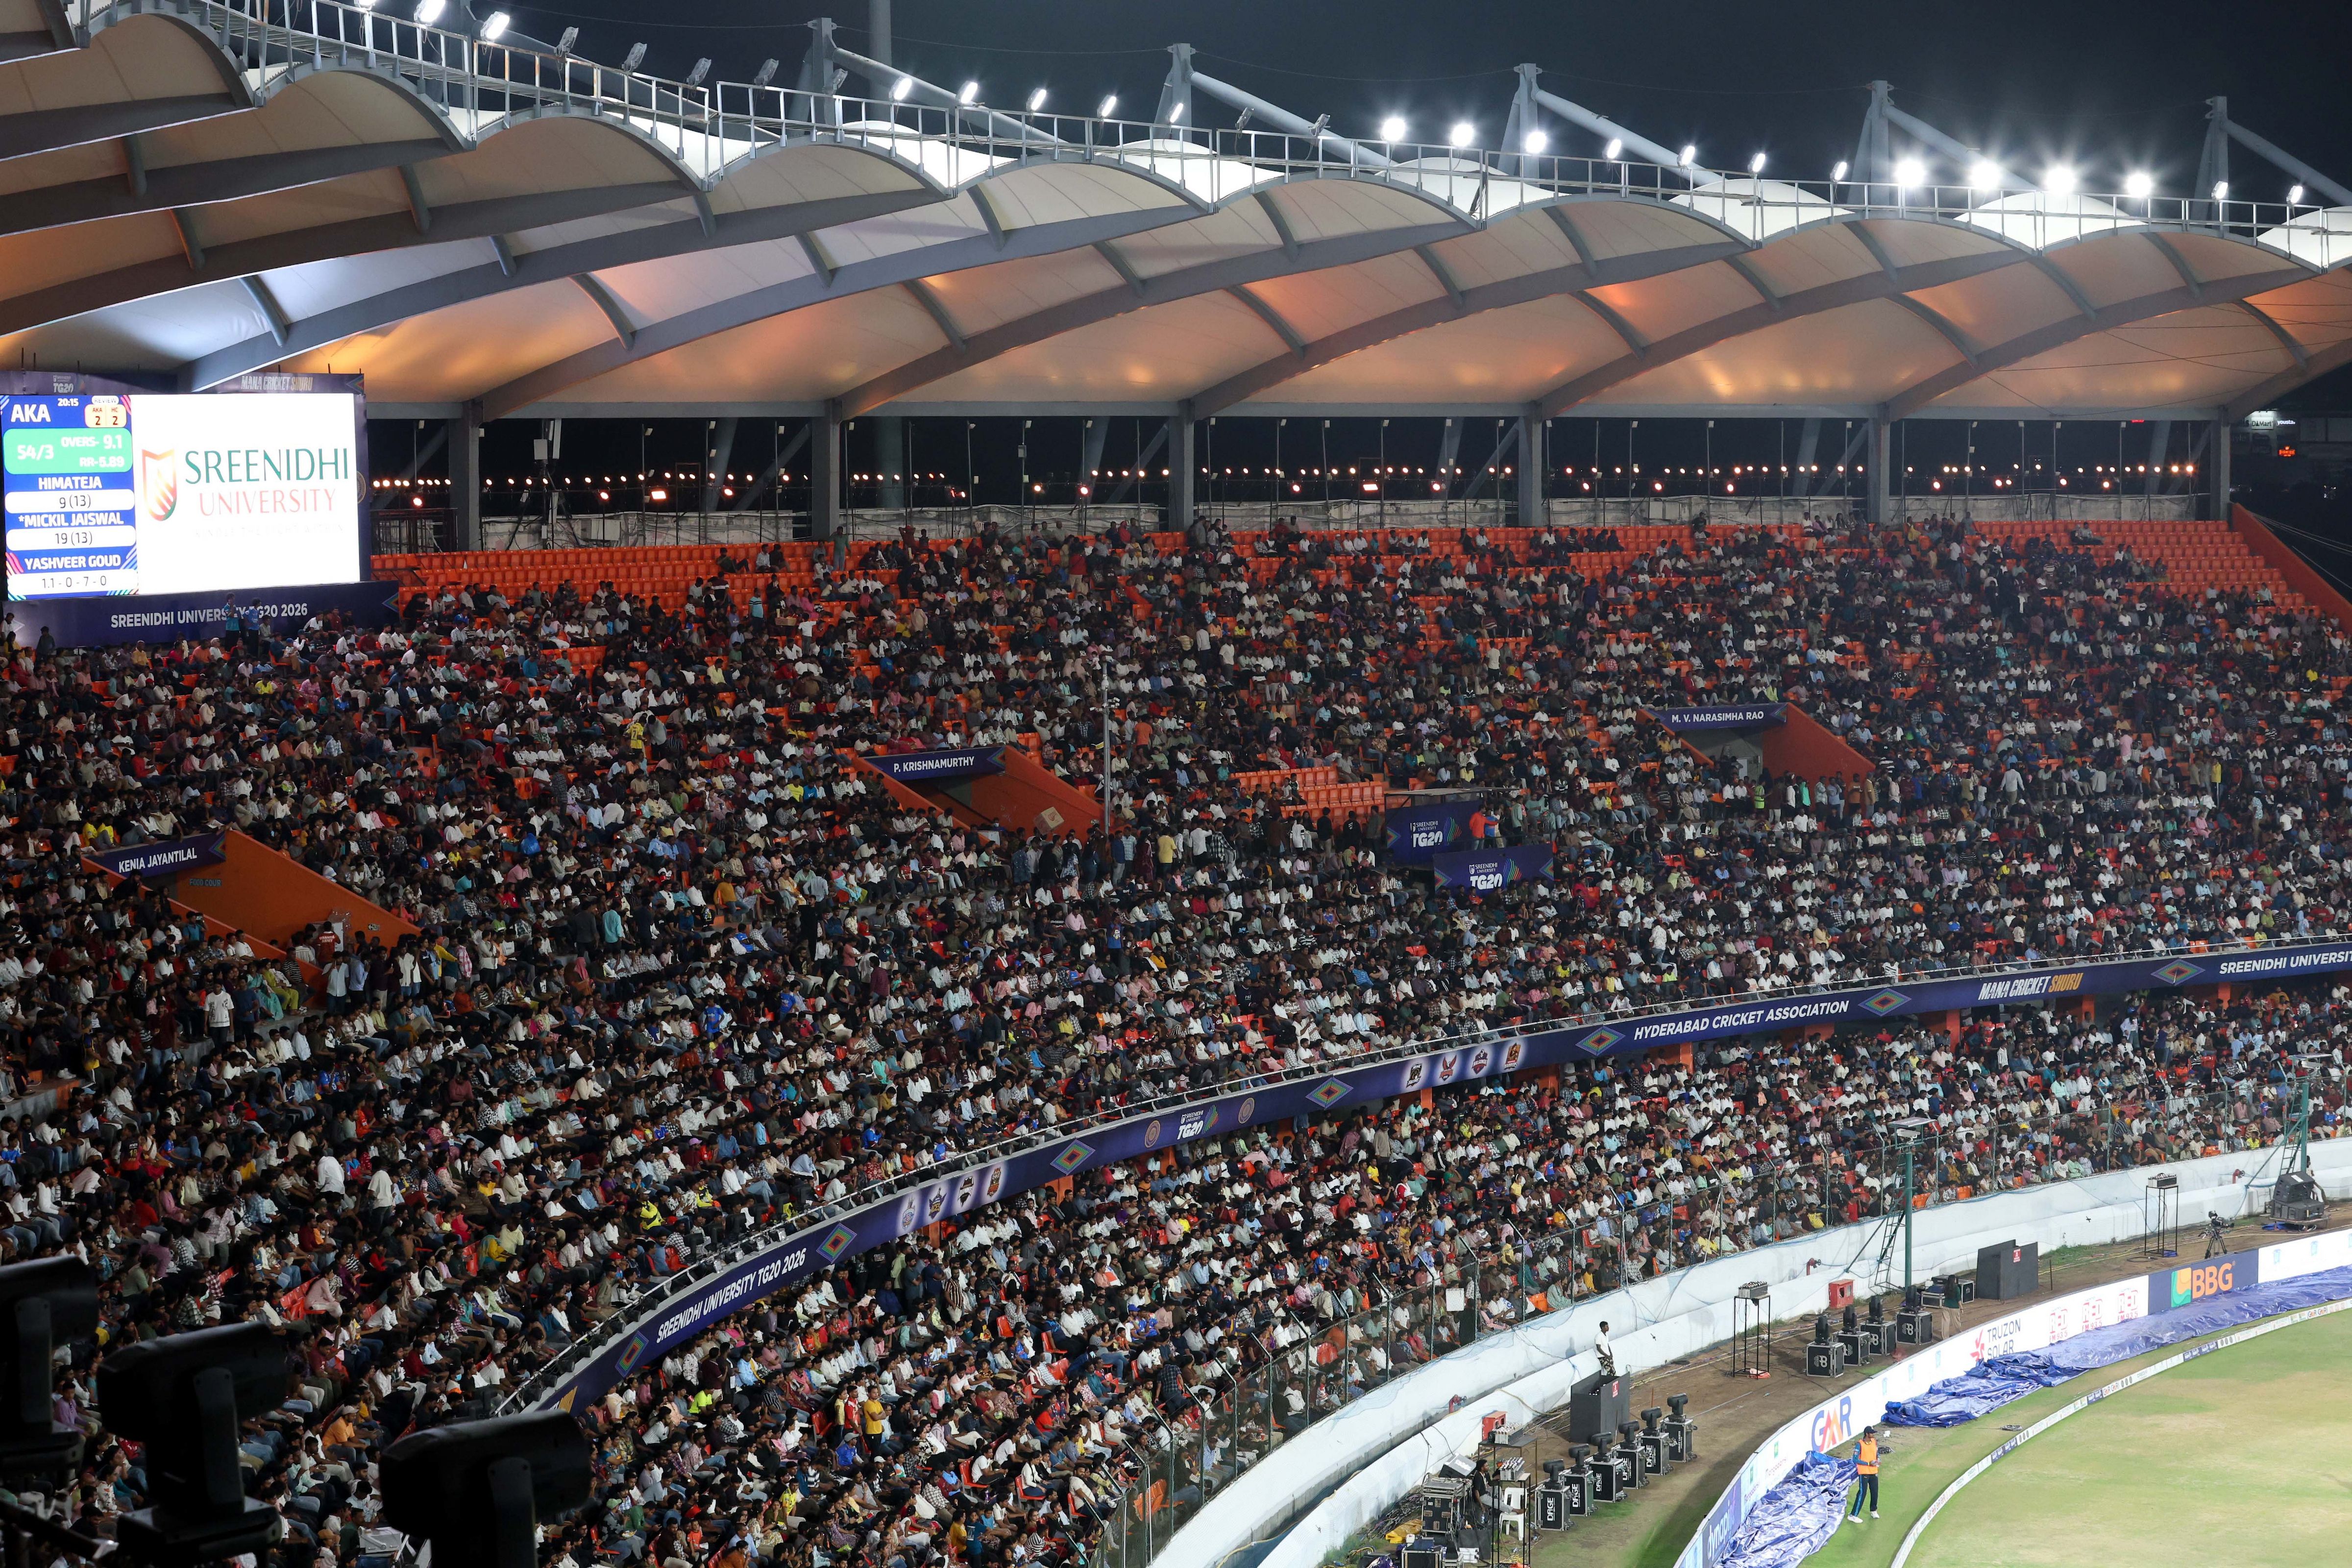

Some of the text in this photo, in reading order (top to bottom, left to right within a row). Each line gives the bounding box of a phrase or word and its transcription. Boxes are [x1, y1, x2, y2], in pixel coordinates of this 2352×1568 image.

[53, 383, 74, 392] TG20
[241, 376, 313, 391] MANA CRICKET SHURU
[58, 398, 79, 406] 20:15
[11, 404, 51, 422] AKA
[96, 416, 100, 425] 2
[113, 416, 118, 425] 2
[103, 435, 122, 449] 9.1
[18, 444, 54, 460] 54/3
[185, 448, 348, 484] SREENIDHI
[38, 476, 102, 490] HIMATEJA
[59, 494, 91, 509] 9 (13)
[199, 489, 336, 516] UNIVERSITY
[71, 512, 124, 526] JAISWAL
[55, 531, 93, 545] 19 (13)
[24, 555, 121, 570] YASHVEER GOUD
[42, 578, 54, 588] 1.1
[66, 577, 72, 587] 0
[83, 576, 89, 586] 7
[100, 575, 106, 586] 0
[111, 612, 174, 628] SREENIDHI
[281, 603, 308, 616] 2026
[1671, 711, 1764, 723] M. V. NARASIMHA RAO
[894, 756, 975, 773] P. KRISHNAMURTHY
[1411, 831, 1443, 847] TG20
[119, 847, 197, 873] KENIA JAYANTILAL
[1470, 873, 1502, 890] TG20
[2219, 959, 2288, 975] SREENIDHI
[1978, 972, 2083, 1000] MANA CRICKET SHURU
[1634, 1000, 1850, 1040] HYDERABAD CRICKET ASSOCIATION
[1186, 1110, 1203, 1119] SREENIDHI
[1177, 1120, 1204, 1140] TG20
[2192, 1263, 2232, 1298] BBG
[656, 1247, 807, 1344] SREENIDHI UNIVERSITY TG20 2026
[1987, 1318, 2020, 1343] TRUZON
[1987, 1339, 2014, 1359] SOLAR
[1812, 1396, 1852, 1452] GMR
